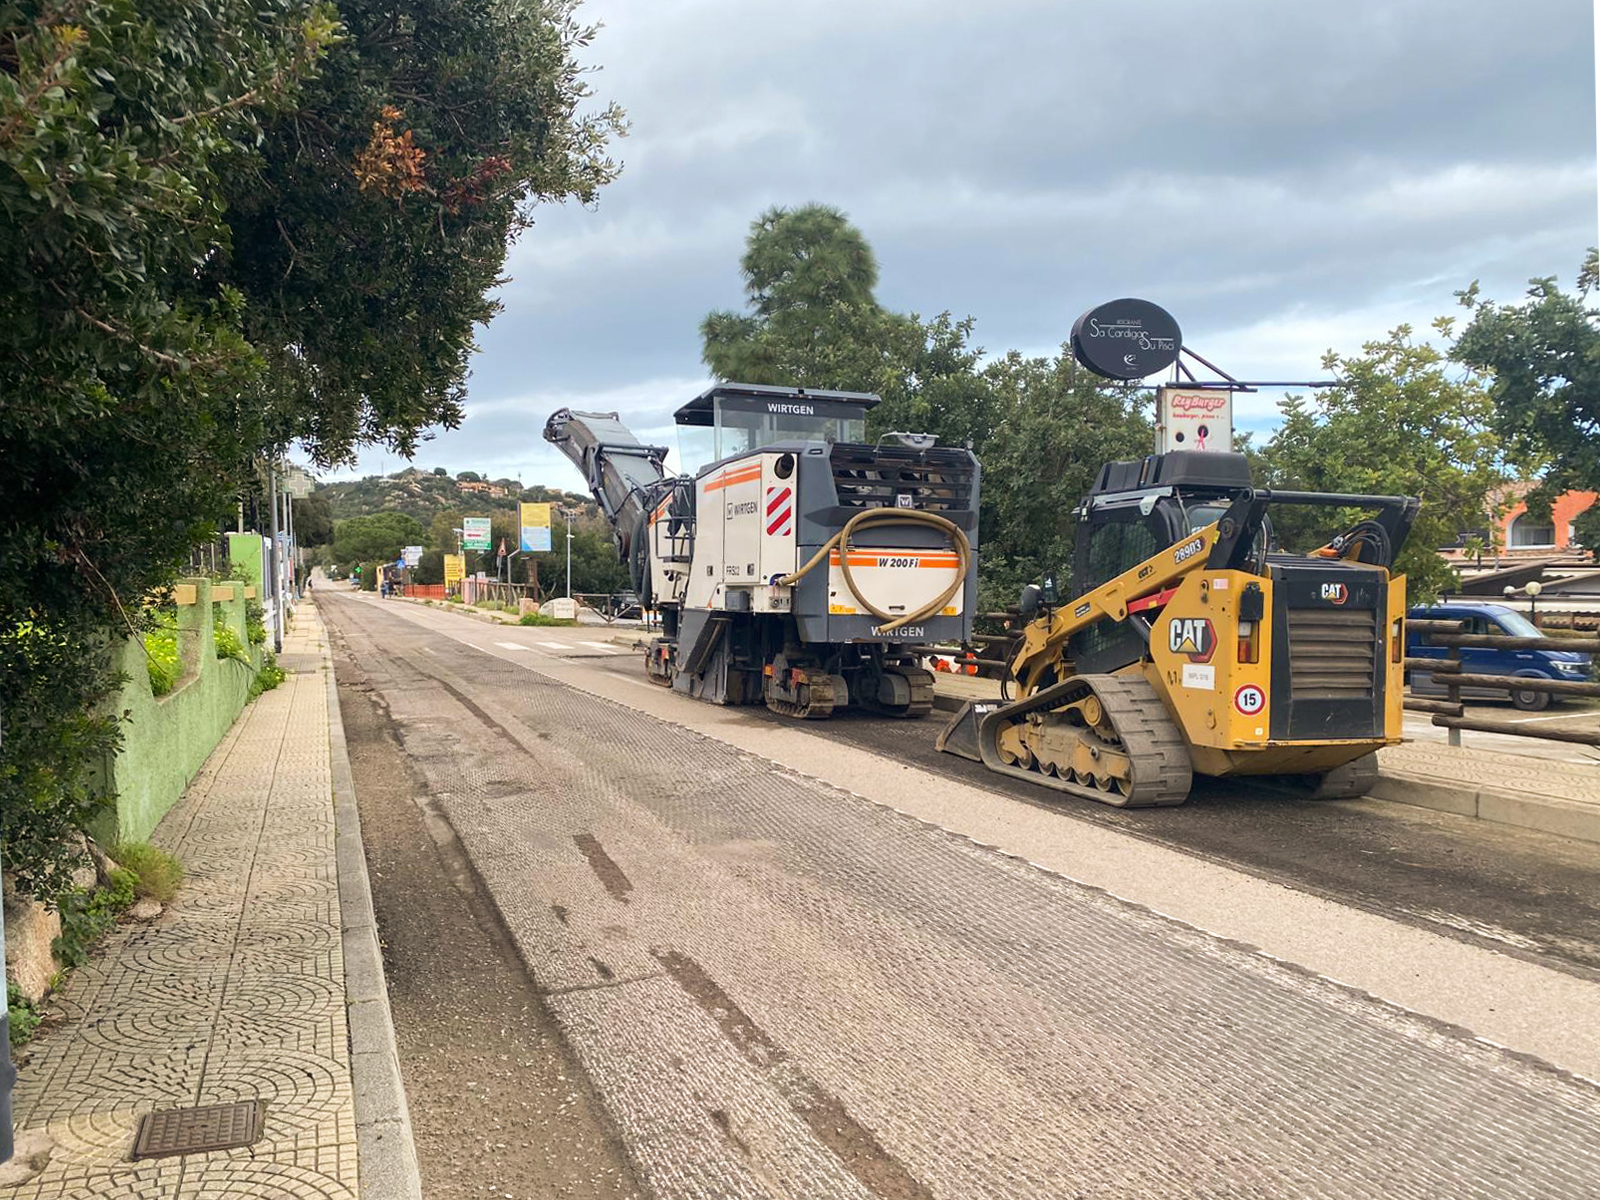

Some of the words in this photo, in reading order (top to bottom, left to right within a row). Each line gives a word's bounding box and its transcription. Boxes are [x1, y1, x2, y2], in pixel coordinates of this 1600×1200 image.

[1090, 318, 1105, 338] Sa
[767, 403, 814, 415] WIRTGEN
[735, 501, 758, 515] WIRTGEN
[879, 558, 889, 567] W
[1321, 583, 1342, 599] CAT
[1170, 618, 1206, 652] CAT
[1243, 693, 1256, 706] 15
